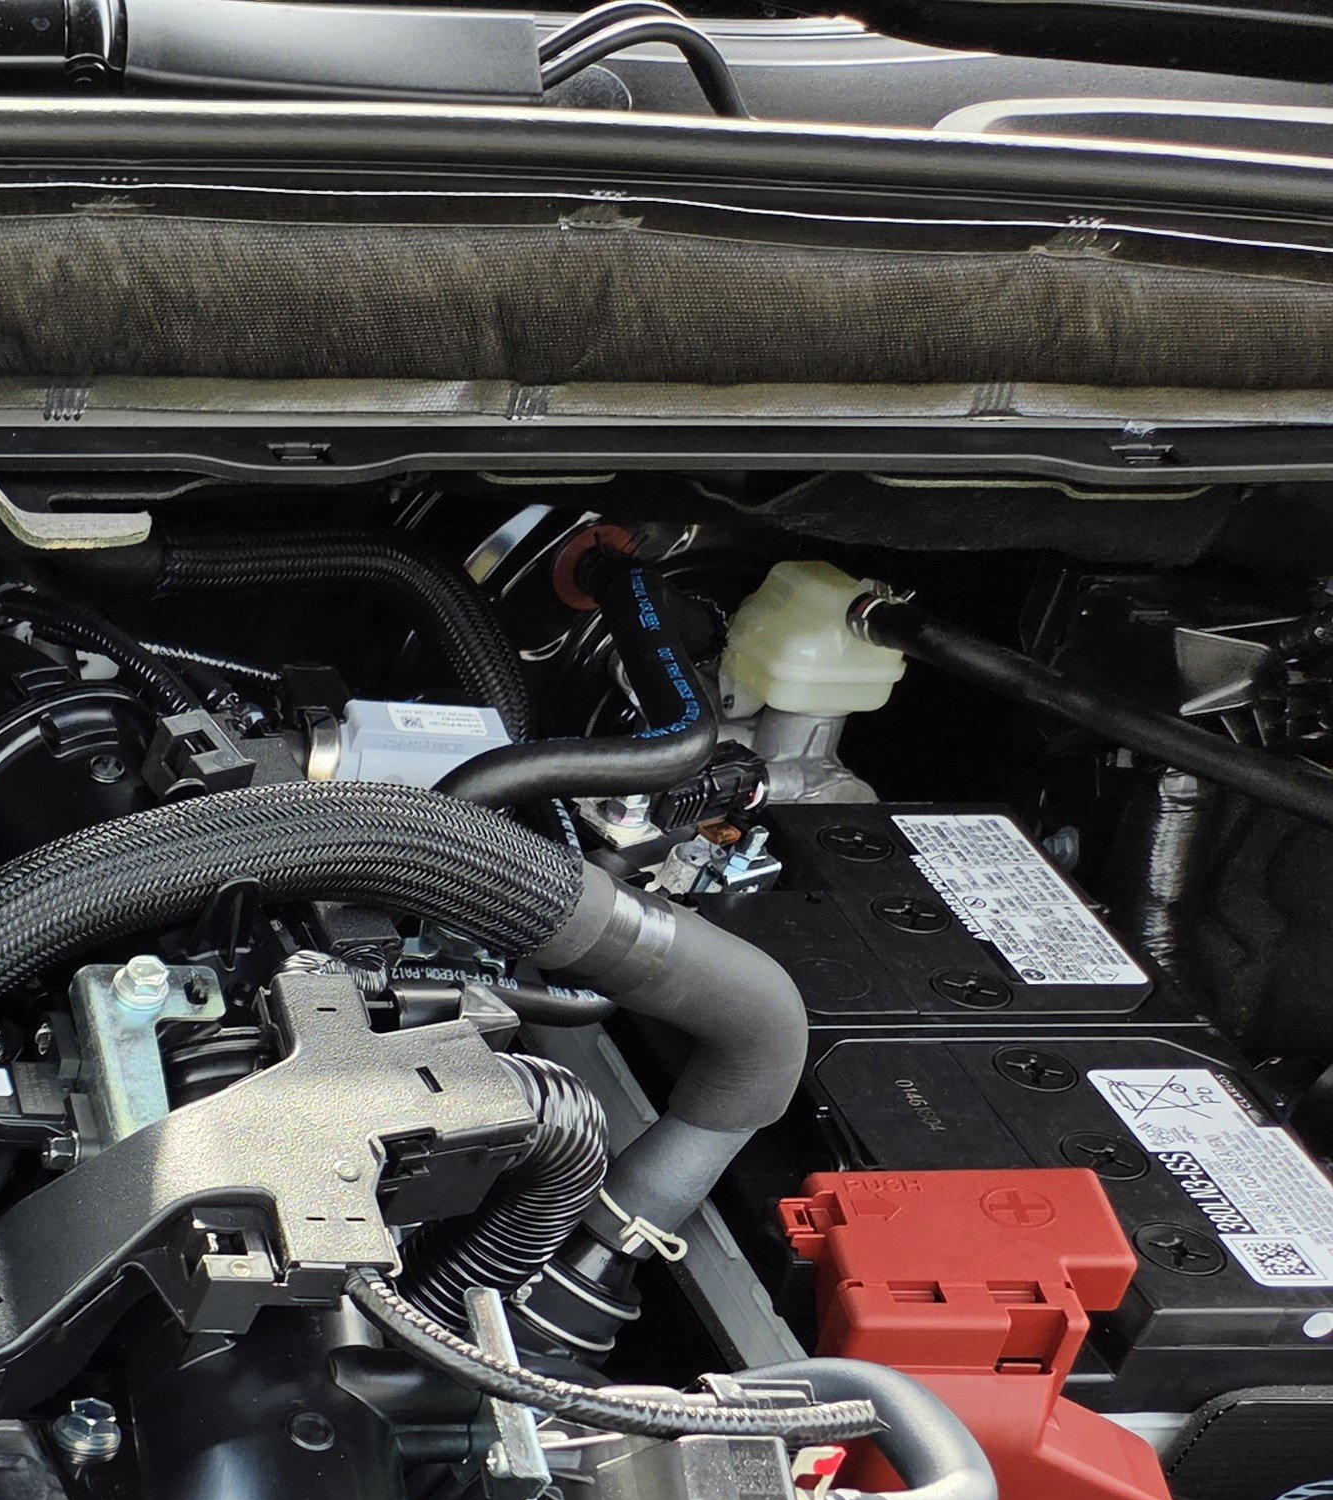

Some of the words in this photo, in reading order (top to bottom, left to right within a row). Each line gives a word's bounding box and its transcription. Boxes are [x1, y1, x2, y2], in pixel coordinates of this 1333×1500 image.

[1196, 1086, 1222, 1104] Pb
[1215, 1073, 1253, 1109] CLARIOS
[843, 1179, 922, 1192] PUSH
[1158, 1152, 1253, 1232] 380LN3-ISS
